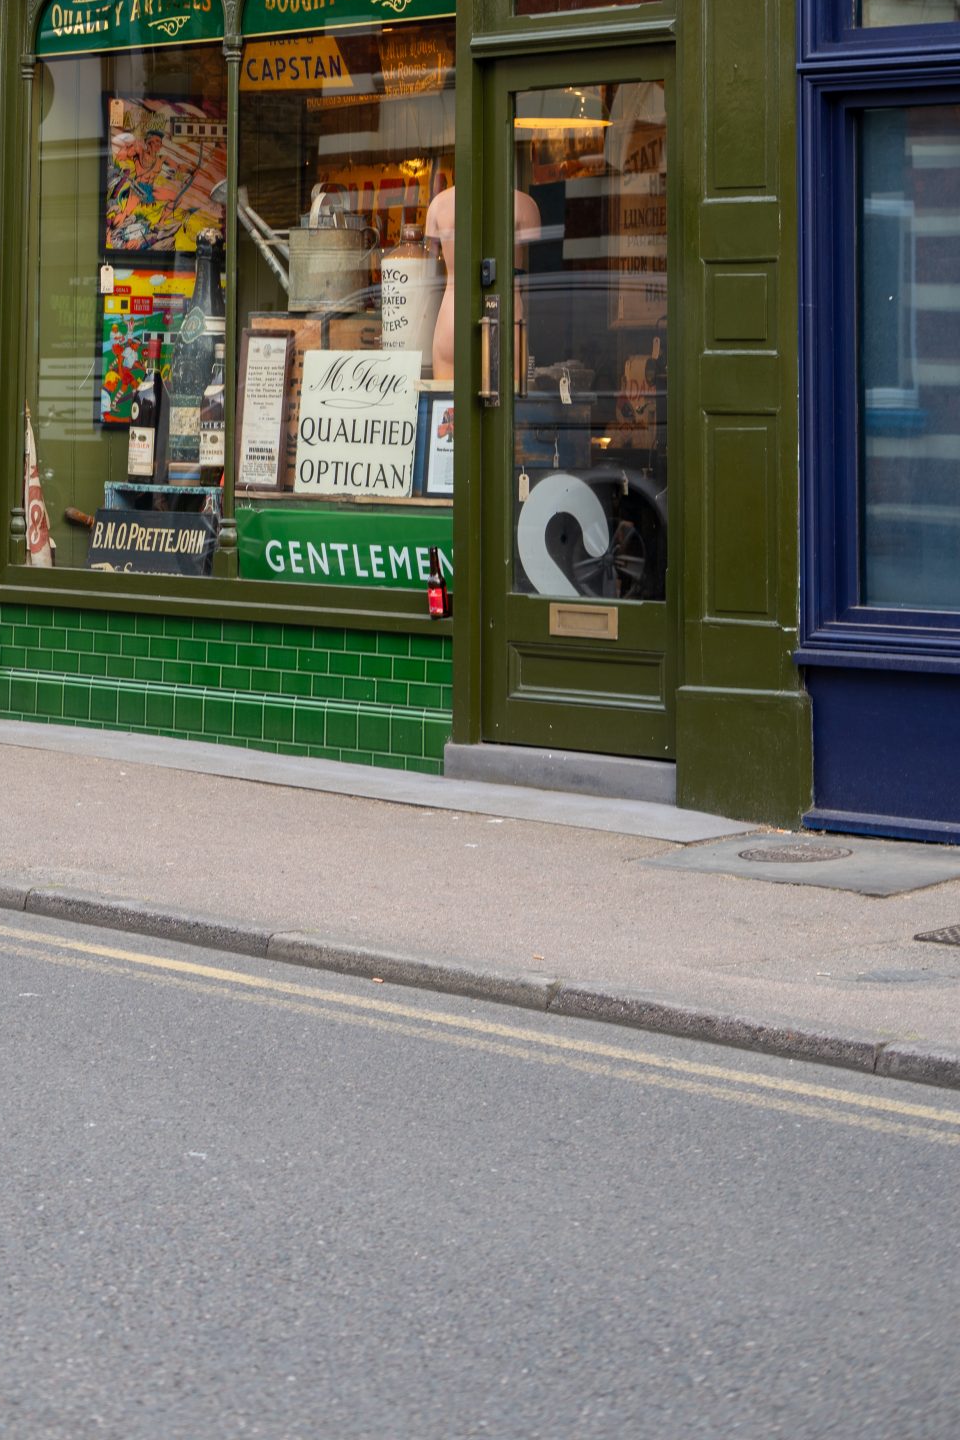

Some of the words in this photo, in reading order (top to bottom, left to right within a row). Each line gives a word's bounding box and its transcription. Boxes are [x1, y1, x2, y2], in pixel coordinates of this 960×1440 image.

[246, 54, 343, 82] CAPSTAN
[300, 416, 414, 447] QUALIFIED
[299, 458, 406, 490] OPTICIAN
